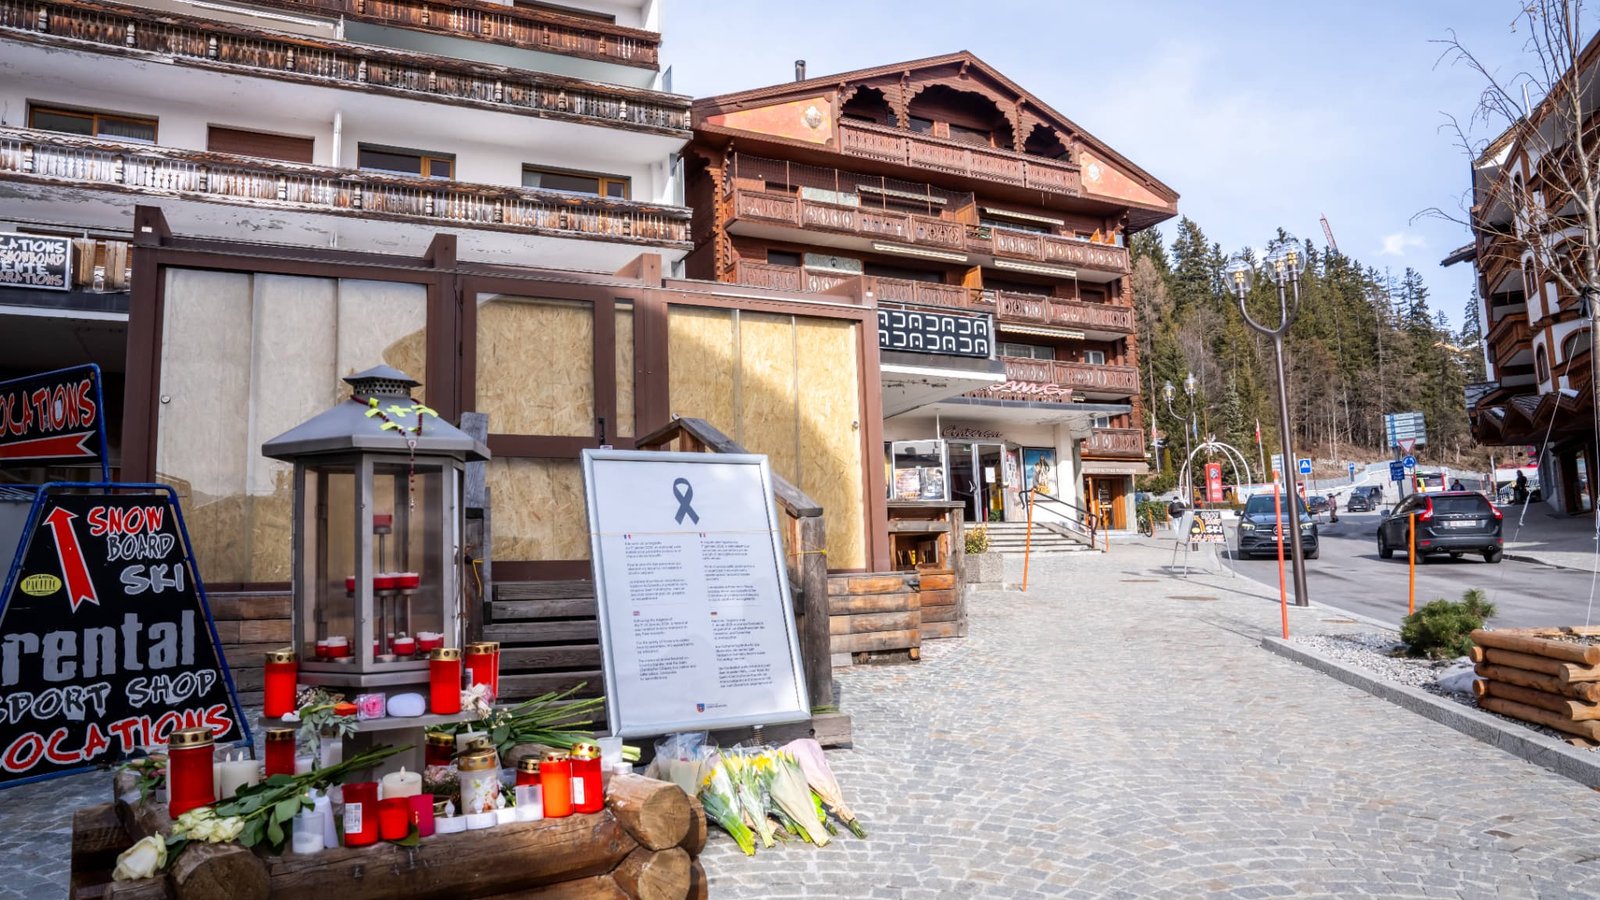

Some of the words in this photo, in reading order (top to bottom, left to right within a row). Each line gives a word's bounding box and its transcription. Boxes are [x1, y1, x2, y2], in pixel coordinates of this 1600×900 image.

[0, 260, 49, 275] ENTE
[87, 506, 164, 536] SNOW
[106, 533, 175, 561] BOARD
[119, 562, 185, 595] SKI
[1, 609, 195, 686] rental
[0, 681, 111, 724] PORT
[127, 669, 217, 707] SHOP
[0, 703, 233, 773] OCATIONS
